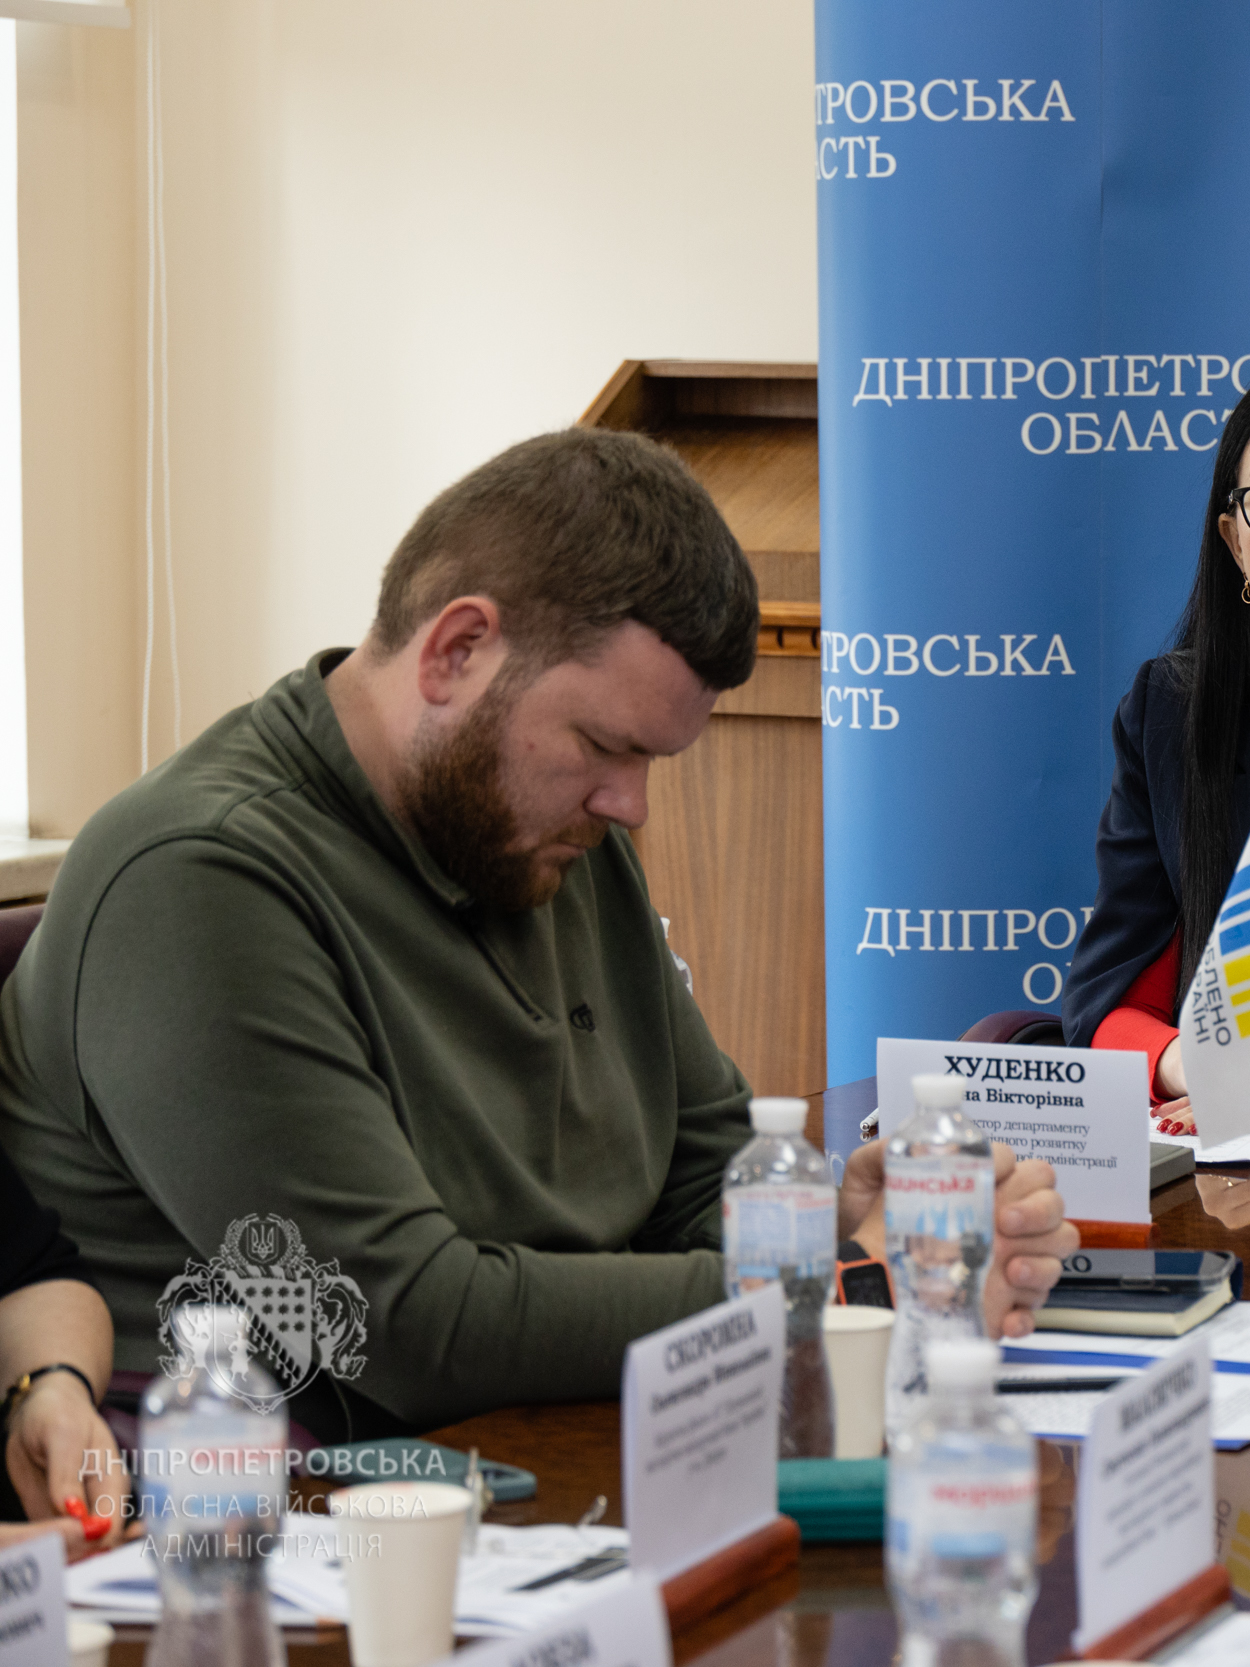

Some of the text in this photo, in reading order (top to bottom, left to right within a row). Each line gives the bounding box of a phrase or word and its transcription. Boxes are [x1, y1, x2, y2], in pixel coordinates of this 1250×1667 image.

[815, 78, 1076, 125] ТРОВСЬКА
[1021, 409, 1233, 455] ОБЛАС
[821, 631, 1076, 677] ТРОВСЬКА
[1205, 943, 1231, 1046] БЛЕНО
[944, 1055, 1086, 1084] ХУДЕНКО
[964, 1088, 1085, 1109] на Вікторівна
[1003, 1120, 1091, 1138] департаменту
[1031, 1136, 1087, 1152] розвитку
